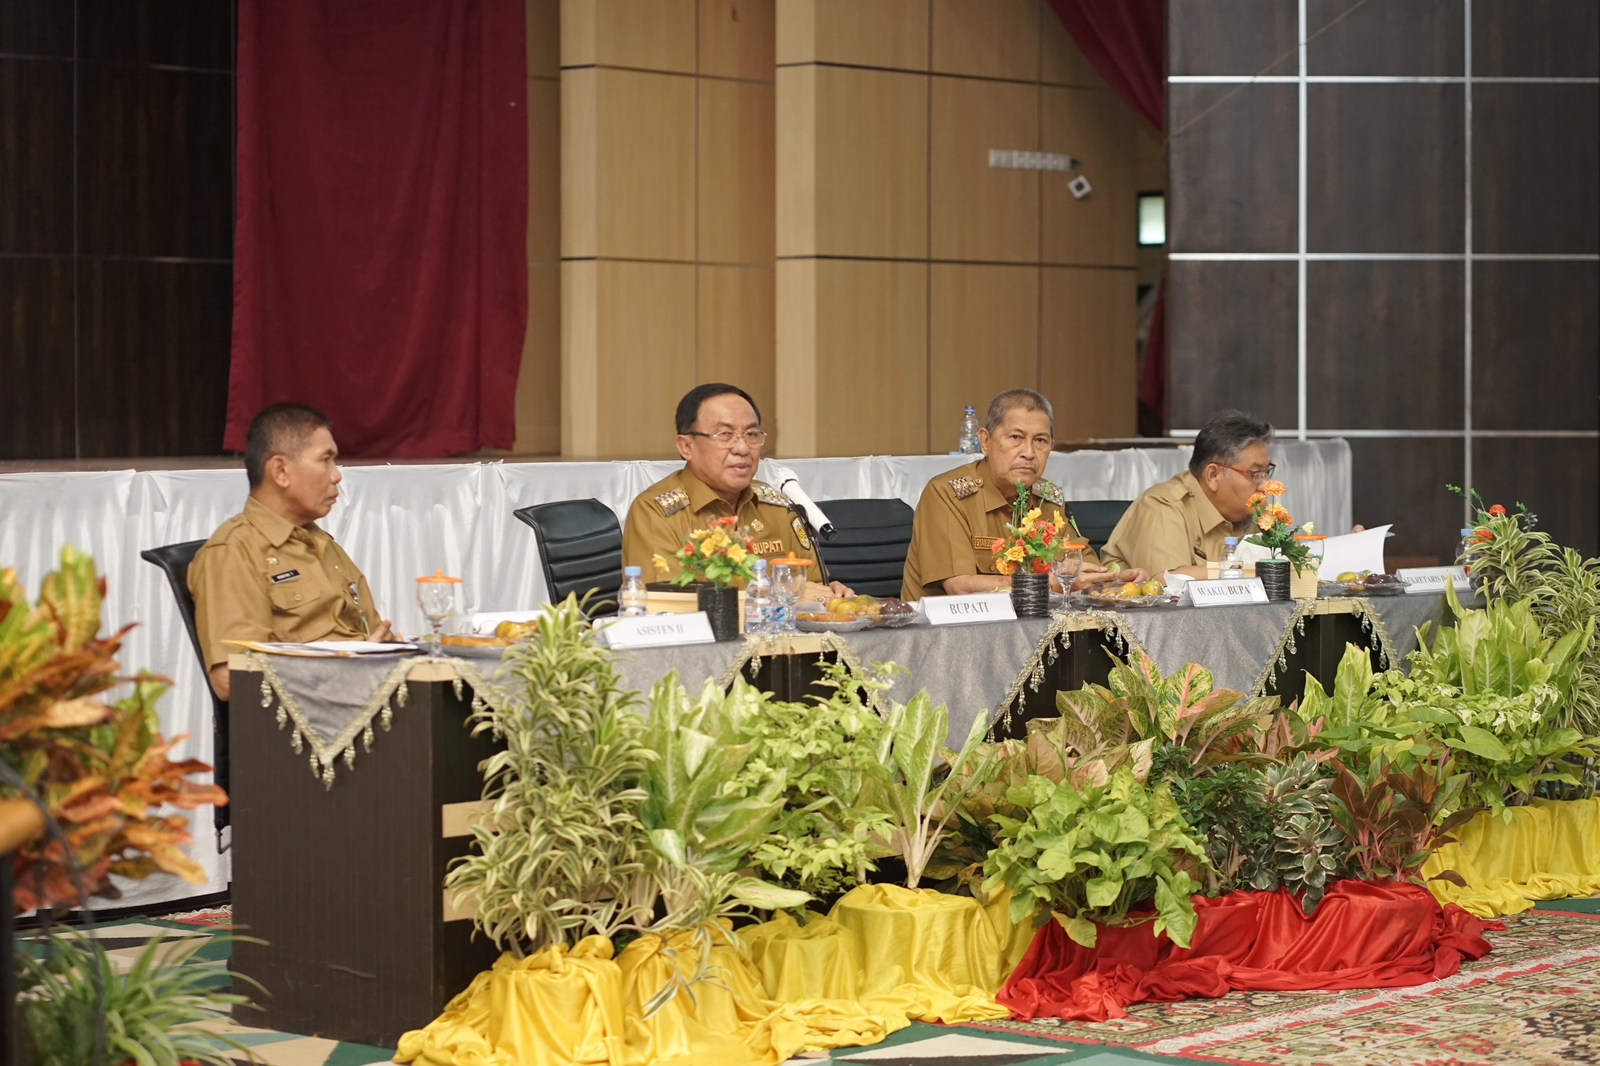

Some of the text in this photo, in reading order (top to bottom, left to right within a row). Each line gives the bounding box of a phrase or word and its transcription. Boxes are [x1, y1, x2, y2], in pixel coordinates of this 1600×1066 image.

[752, 540, 783, 555] BUPATI
[1441, 574, 1466, 583] DRAH
[1197, 584, 1255, 597] WAKIL BUPA
[949, 602, 989, 615] BUPATI
[636, 623, 685, 636] ASISTEN II
